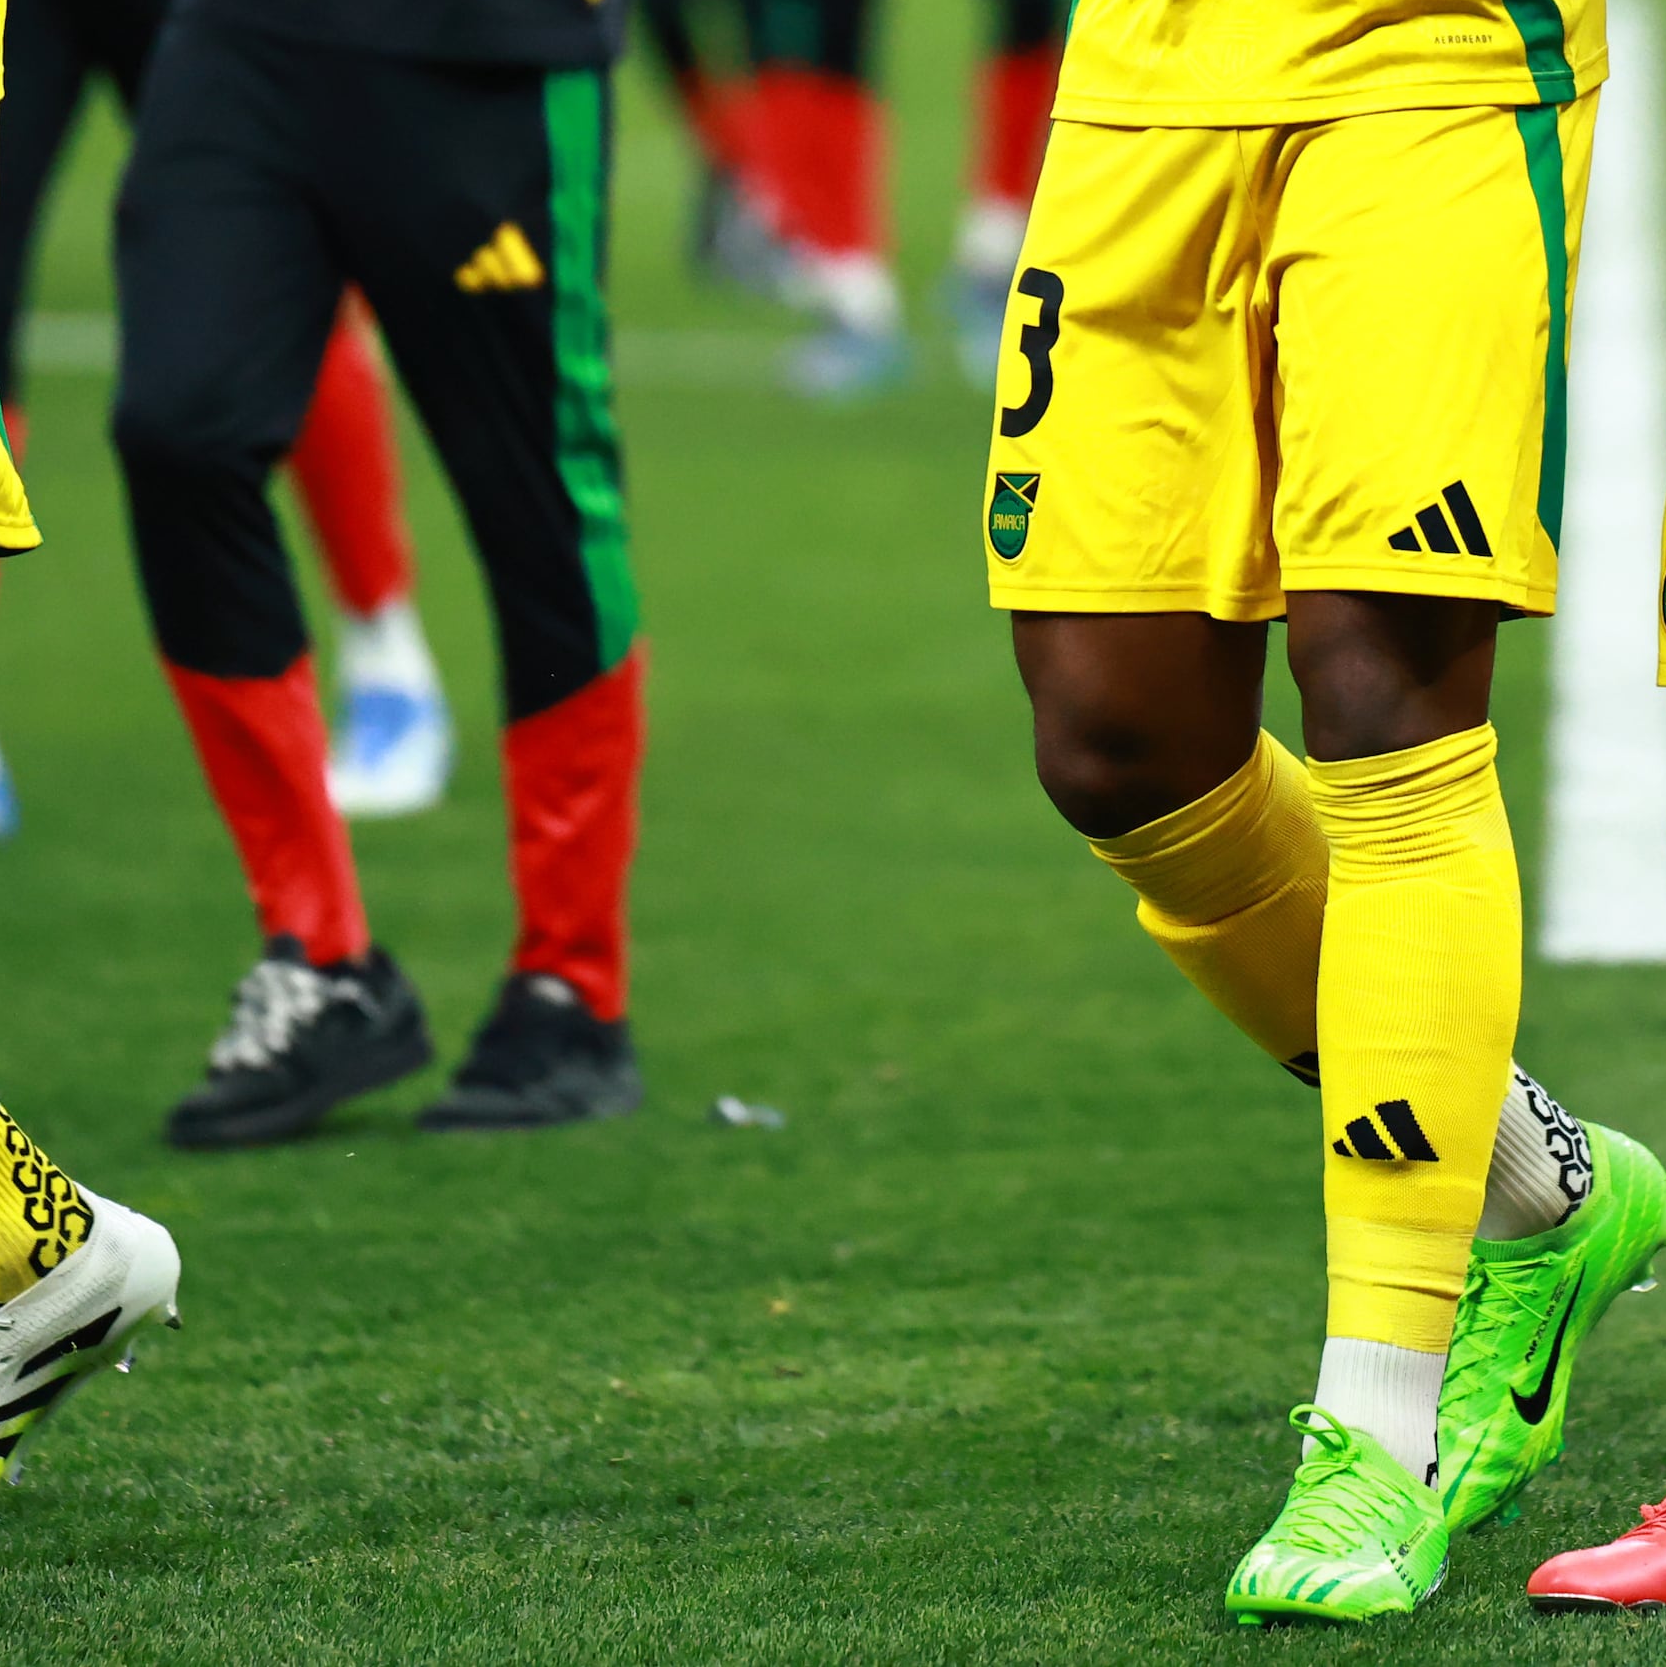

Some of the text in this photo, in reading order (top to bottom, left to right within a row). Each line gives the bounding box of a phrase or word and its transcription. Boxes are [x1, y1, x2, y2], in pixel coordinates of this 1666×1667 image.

[1434, 34, 1493, 44] AEROREADY
[1000, 266, 1064, 438] 3
[991, 513, 1025, 531] JAMAICA
